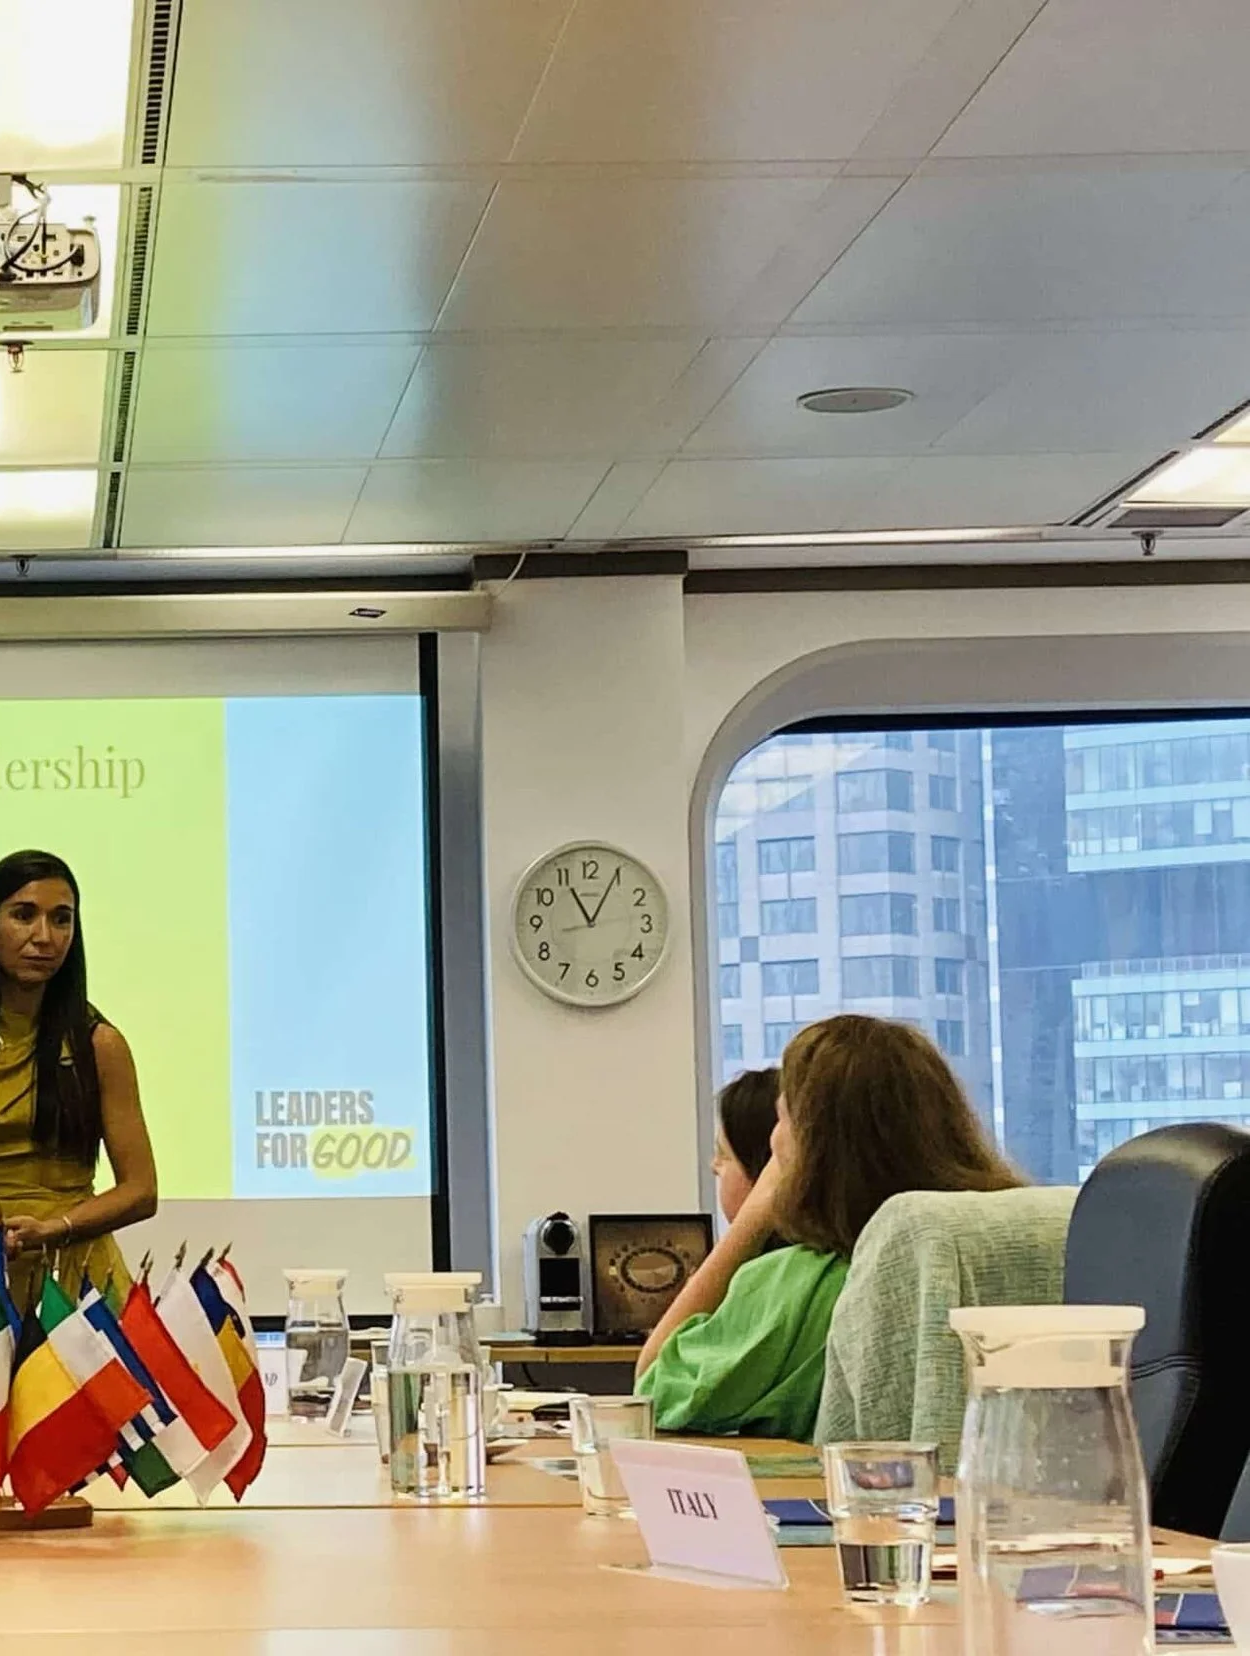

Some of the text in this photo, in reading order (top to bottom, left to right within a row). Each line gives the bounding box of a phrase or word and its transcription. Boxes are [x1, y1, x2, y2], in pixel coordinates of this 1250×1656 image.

[557, 868, 569, 886] 11
[582, 860, 599, 880] 12
[535, 888, 554, 906] 10
[633, 888, 646, 906] 2
[529, 915, 543, 933] 9
[640, 914, 653, 933] 3
[538, 941, 550, 961] 8
[631, 943, 645, 961] 4
[558, 963, 570, 981] 7
[585, 969, 599, 987] 6
[612, 962, 625, 981] 5
[255, 1090, 375, 1127] LEADERS
[256, 1131, 412, 1169] FOR GOOD
[666, 1487, 719, 1521] ITALY
